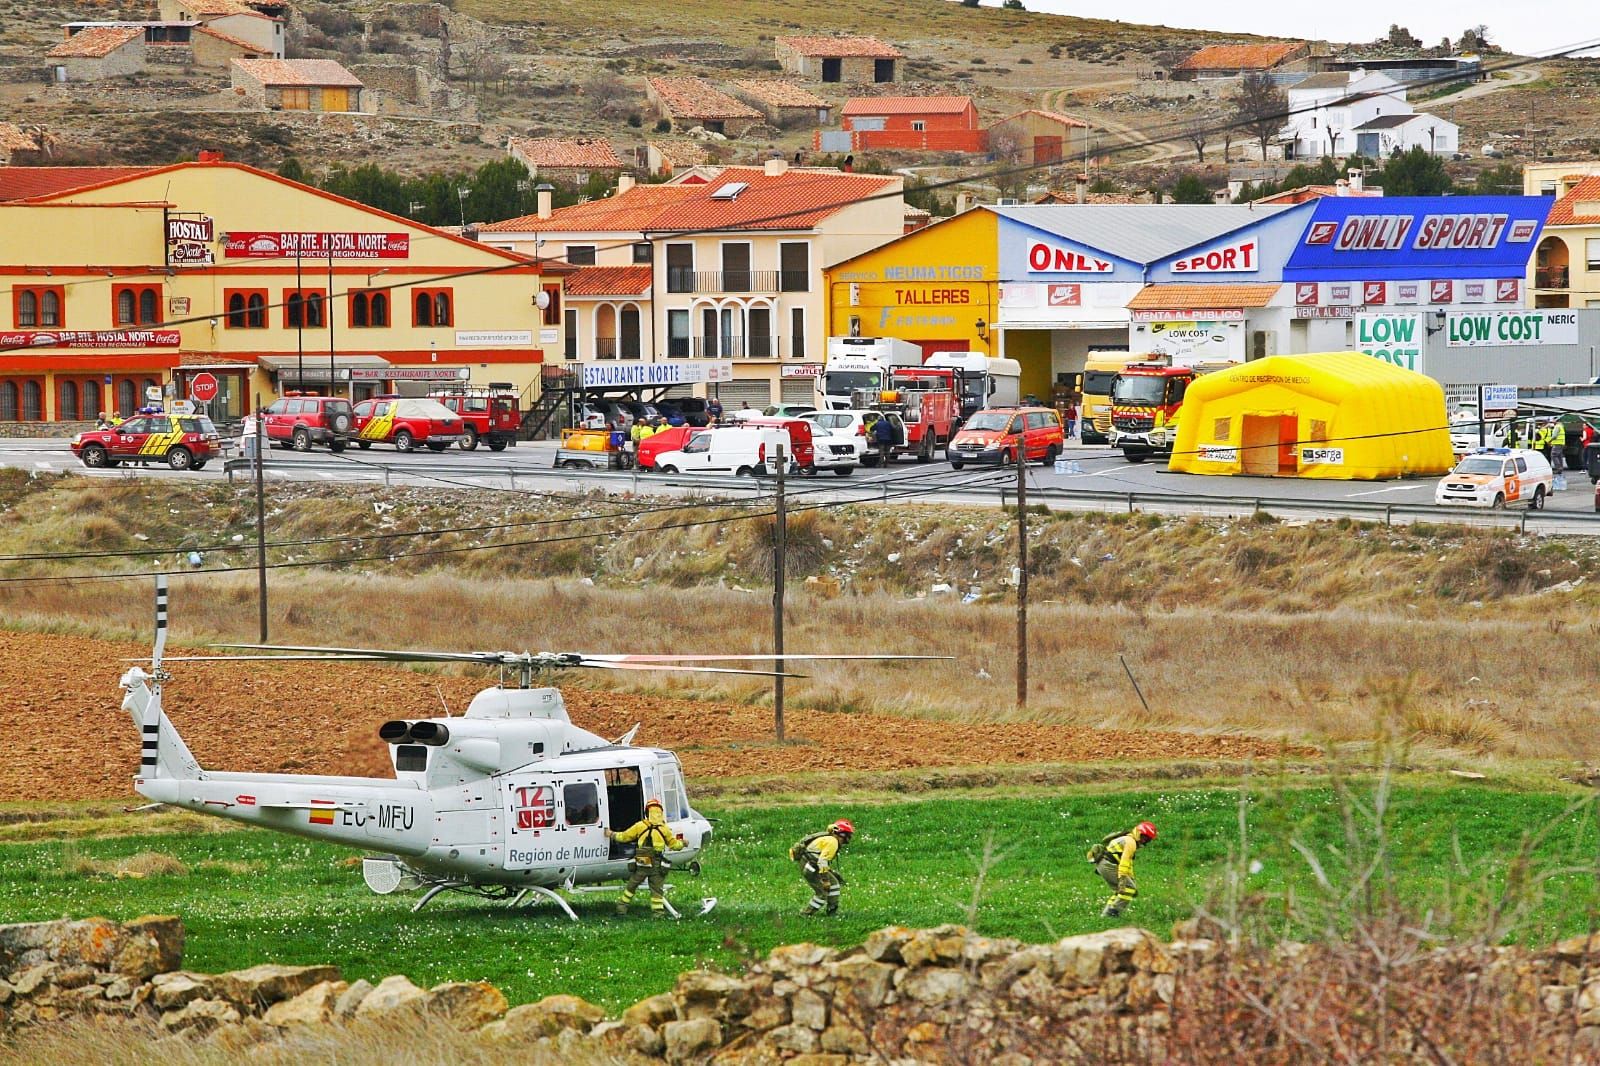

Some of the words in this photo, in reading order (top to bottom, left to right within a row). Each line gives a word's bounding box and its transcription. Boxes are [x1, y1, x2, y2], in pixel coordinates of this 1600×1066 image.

[169, 222, 208, 240] HOSTAL
[1340, 219, 1412, 248] ONLY
[1418, 218, 1506, 248] SPORT
[281, 233, 299, 250] BAR
[301, 234, 319, 250] RTE.
[322, 234, 355, 250] HOSTAL
[358, 234, 387, 250] NORTE
[1029, 243, 1110, 271] ONLY
[1175, 243, 1254, 271] SPORT
[896, 289, 970, 305] TALLERES
[1135, 312, 1170, 320] VENTA
[1191, 311, 1241, 319] PUBLICO
[1297, 308, 1320, 317] VENTA
[1324, 308, 1333, 317] AL
[1548, 314, 1575, 324] NERIC
[60, 332, 76, 342] BAR
[97, 332, 127, 342] HOSTAL
[128, 331, 155, 342] NORTE
[1360, 318, 1416, 342] LOW
[1450, 317, 1492, 341] LOW
[1498, 315, 1544, 340] COST
[385, 370, 430, 378] RESTAURANTE
[584, 365, 644, 384] ESTAURANTE
[649, 365, 679, 383] NORTE
[195, 384, 214, 392] STOP
[1315, 449, 1342, 462] sarga
[509, 848, 553, 865] Región
[556, 846, 570, 859] de
[573, 844, 609, 860] Murcia
